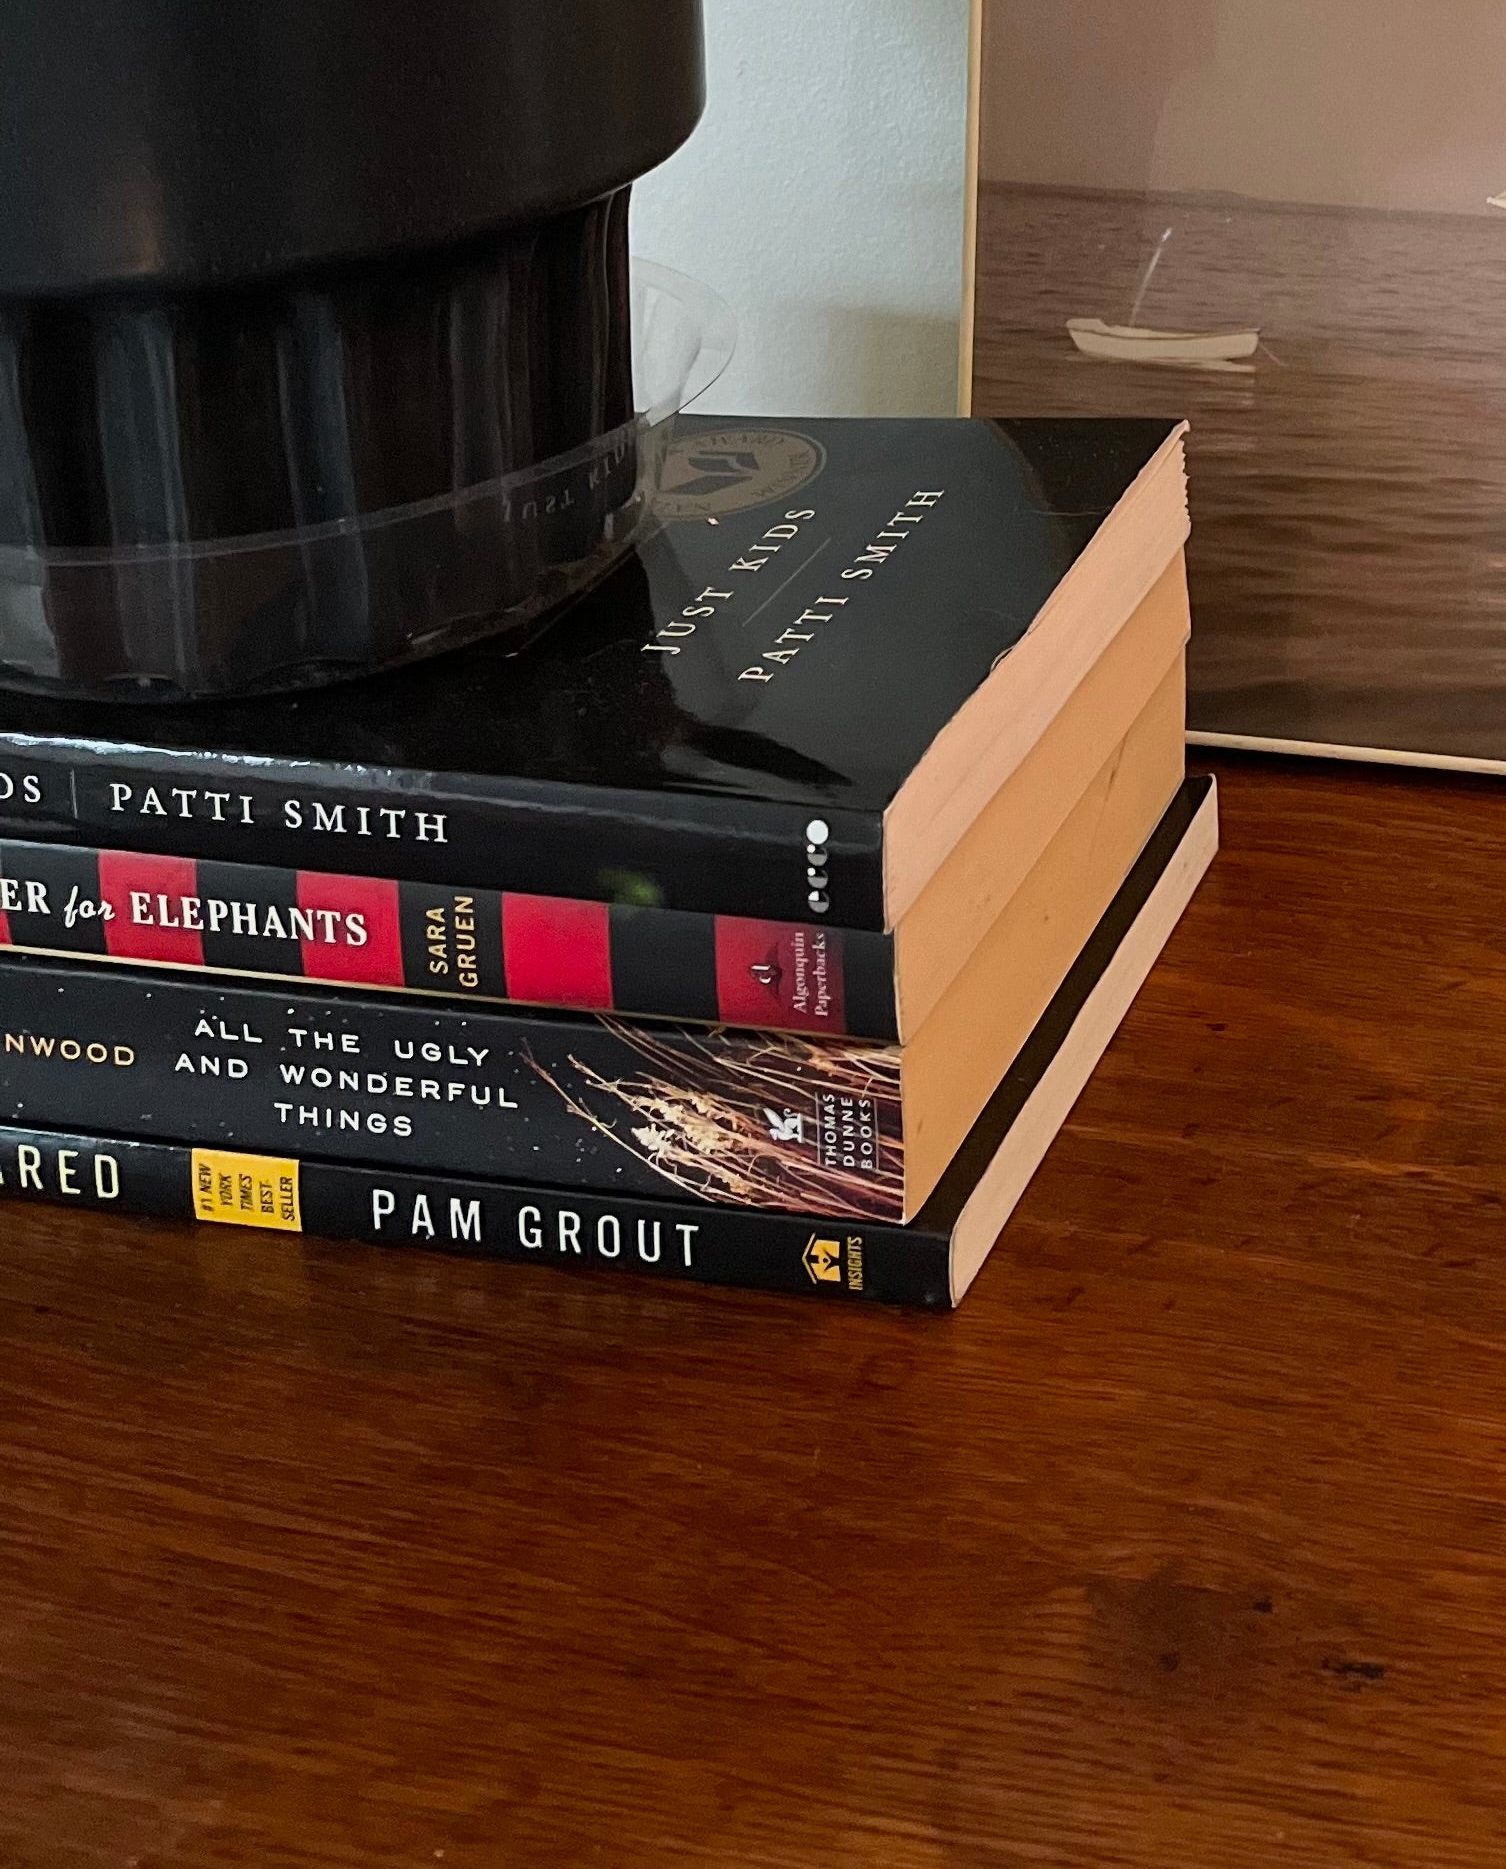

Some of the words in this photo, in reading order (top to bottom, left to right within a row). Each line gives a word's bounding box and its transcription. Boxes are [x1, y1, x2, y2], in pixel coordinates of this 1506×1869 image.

[640, 586, 735, 656] JUST
[728, 508, 816, 572] KIDS
[737, 595, 849, 683] PATTI
[840, 489, 945, 581] SMITH
[110, 782, 254, 824] PATTI
[284, 799, 448, 843] SMITH
[0, 877, 51, 915] ER
[64, 885, 116, 929] for
[129, 891, 369, 947] ELEPHANTS
[425, 906, 448, 975] SARA
[455, 894, 480, 988] GRUEN
[791, 932, 809, 1013] Algonquin
[812, 932, 830, 1017] Paperbacks
[4, 1034, 136, 1067] NWOOD
[194, 1018, 263, 1045] ALL
[288, 1027, 361, 1055] THE
[393, 1038, 491, 1068] UGLY
[174, 1052, 249, 1080] AND
[279, 1063, 520, 1110] WONDERFUL
[273, 1101, 413, 1138] THINGS
[822, 1094, 837, 1167] THOMAS
[841, 1097, 855, 1167] DUNNE
[859, 1100, 874, 1170] BOOKS
[0, 1144, 121, 1199] RED
[199, 1163, 212, 1194] NEW
[218, 1173, 233, 1206] YORK
[239, 1174, 253, 1211] TIMES
[280, 1176, 294, 1222] SELLER
[372, 1188, 482, 1242] PAM
[518, 1205, 699, 1267] GROUT
[847, 1235, 863, 1291] INSIGHTS
